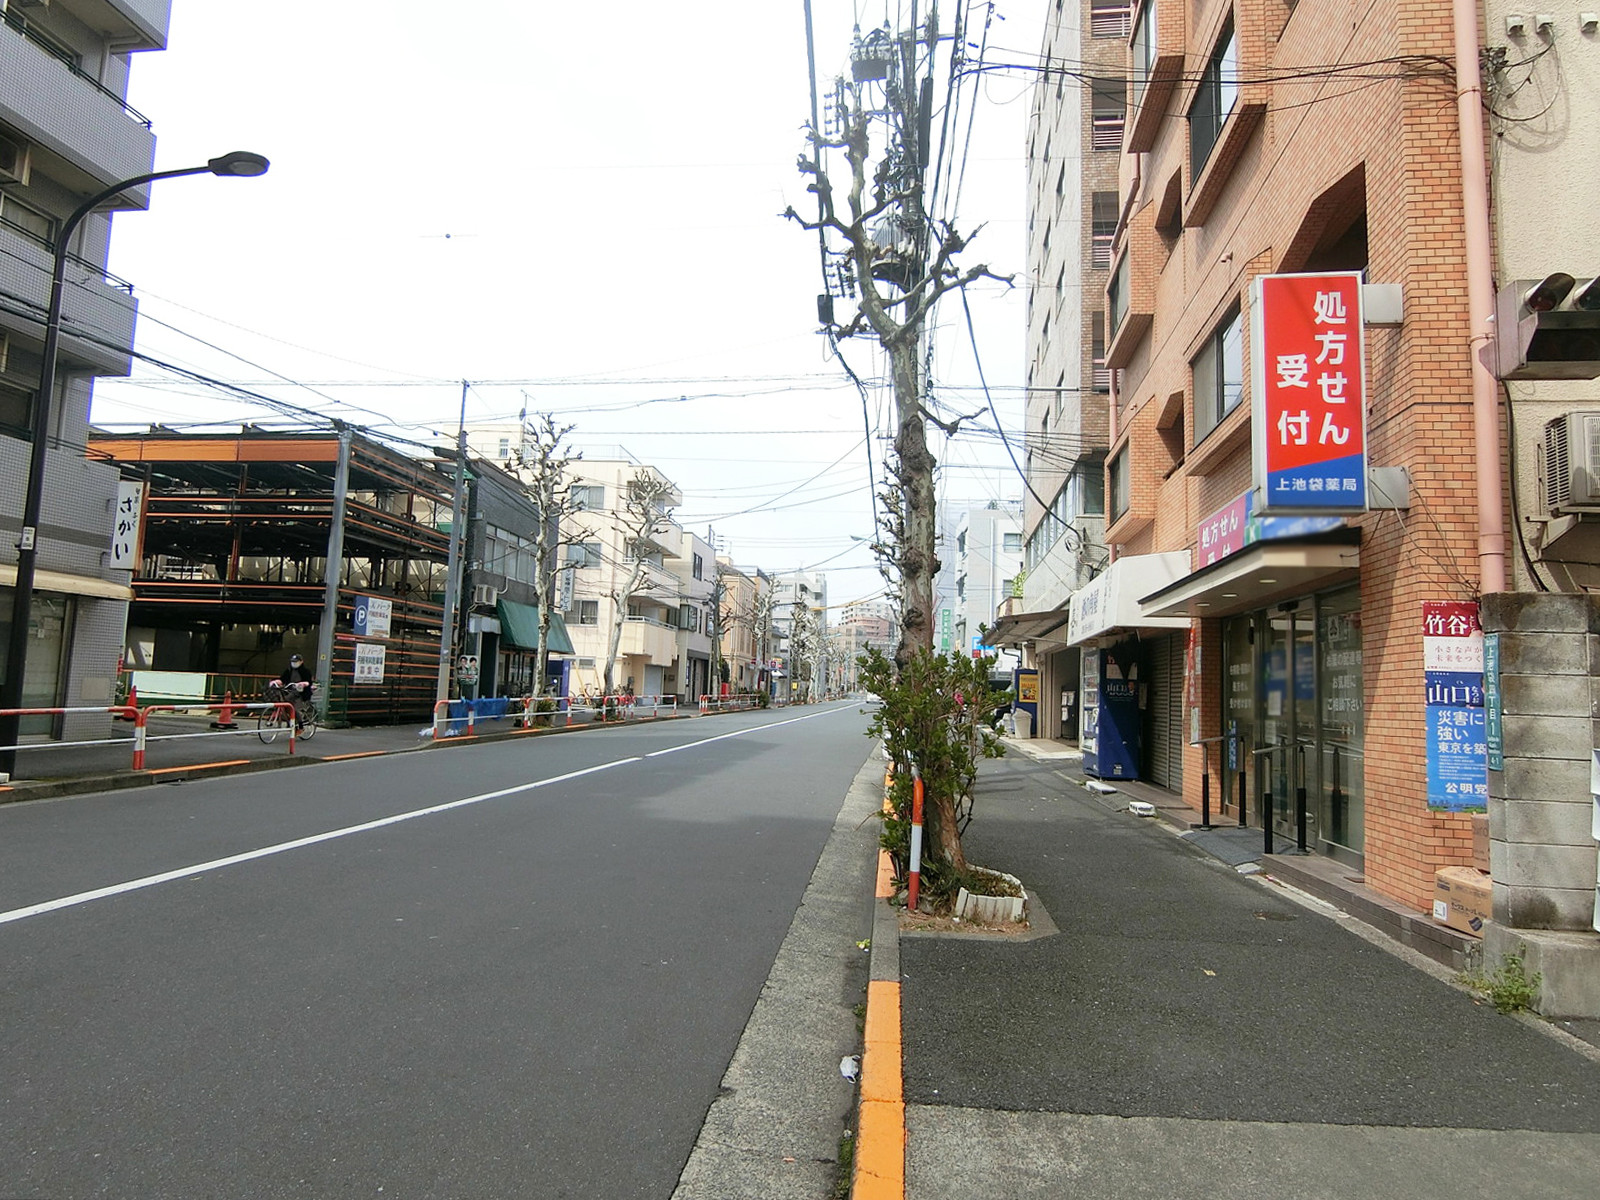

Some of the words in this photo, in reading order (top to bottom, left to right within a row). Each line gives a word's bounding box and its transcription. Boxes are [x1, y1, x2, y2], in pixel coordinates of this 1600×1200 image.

[1313, 291, 1350, 445] 処方せん
[1276, 353, 1310, 446] 受付
[1275, 478, 1357, 492] 上池袋薬局
[1201, 509, 1239, 550] 処方せん
[1425, 614, 1469, 635] 竹谷
[1435, 645, 1483, 654] 小さな声が
[1332, 674, 1357, 689] お気軽に
[1428, 684, 1470, 704] 山口
[1471, 685, 1480, 704] なつお
[1327, 696, 1363, 712] ご相談下さい
[1437, 710, 1484, 726] 災害に
[1437, 726, 1469, 741] 強い
[1445, 782, 1487, 794] 公明党
